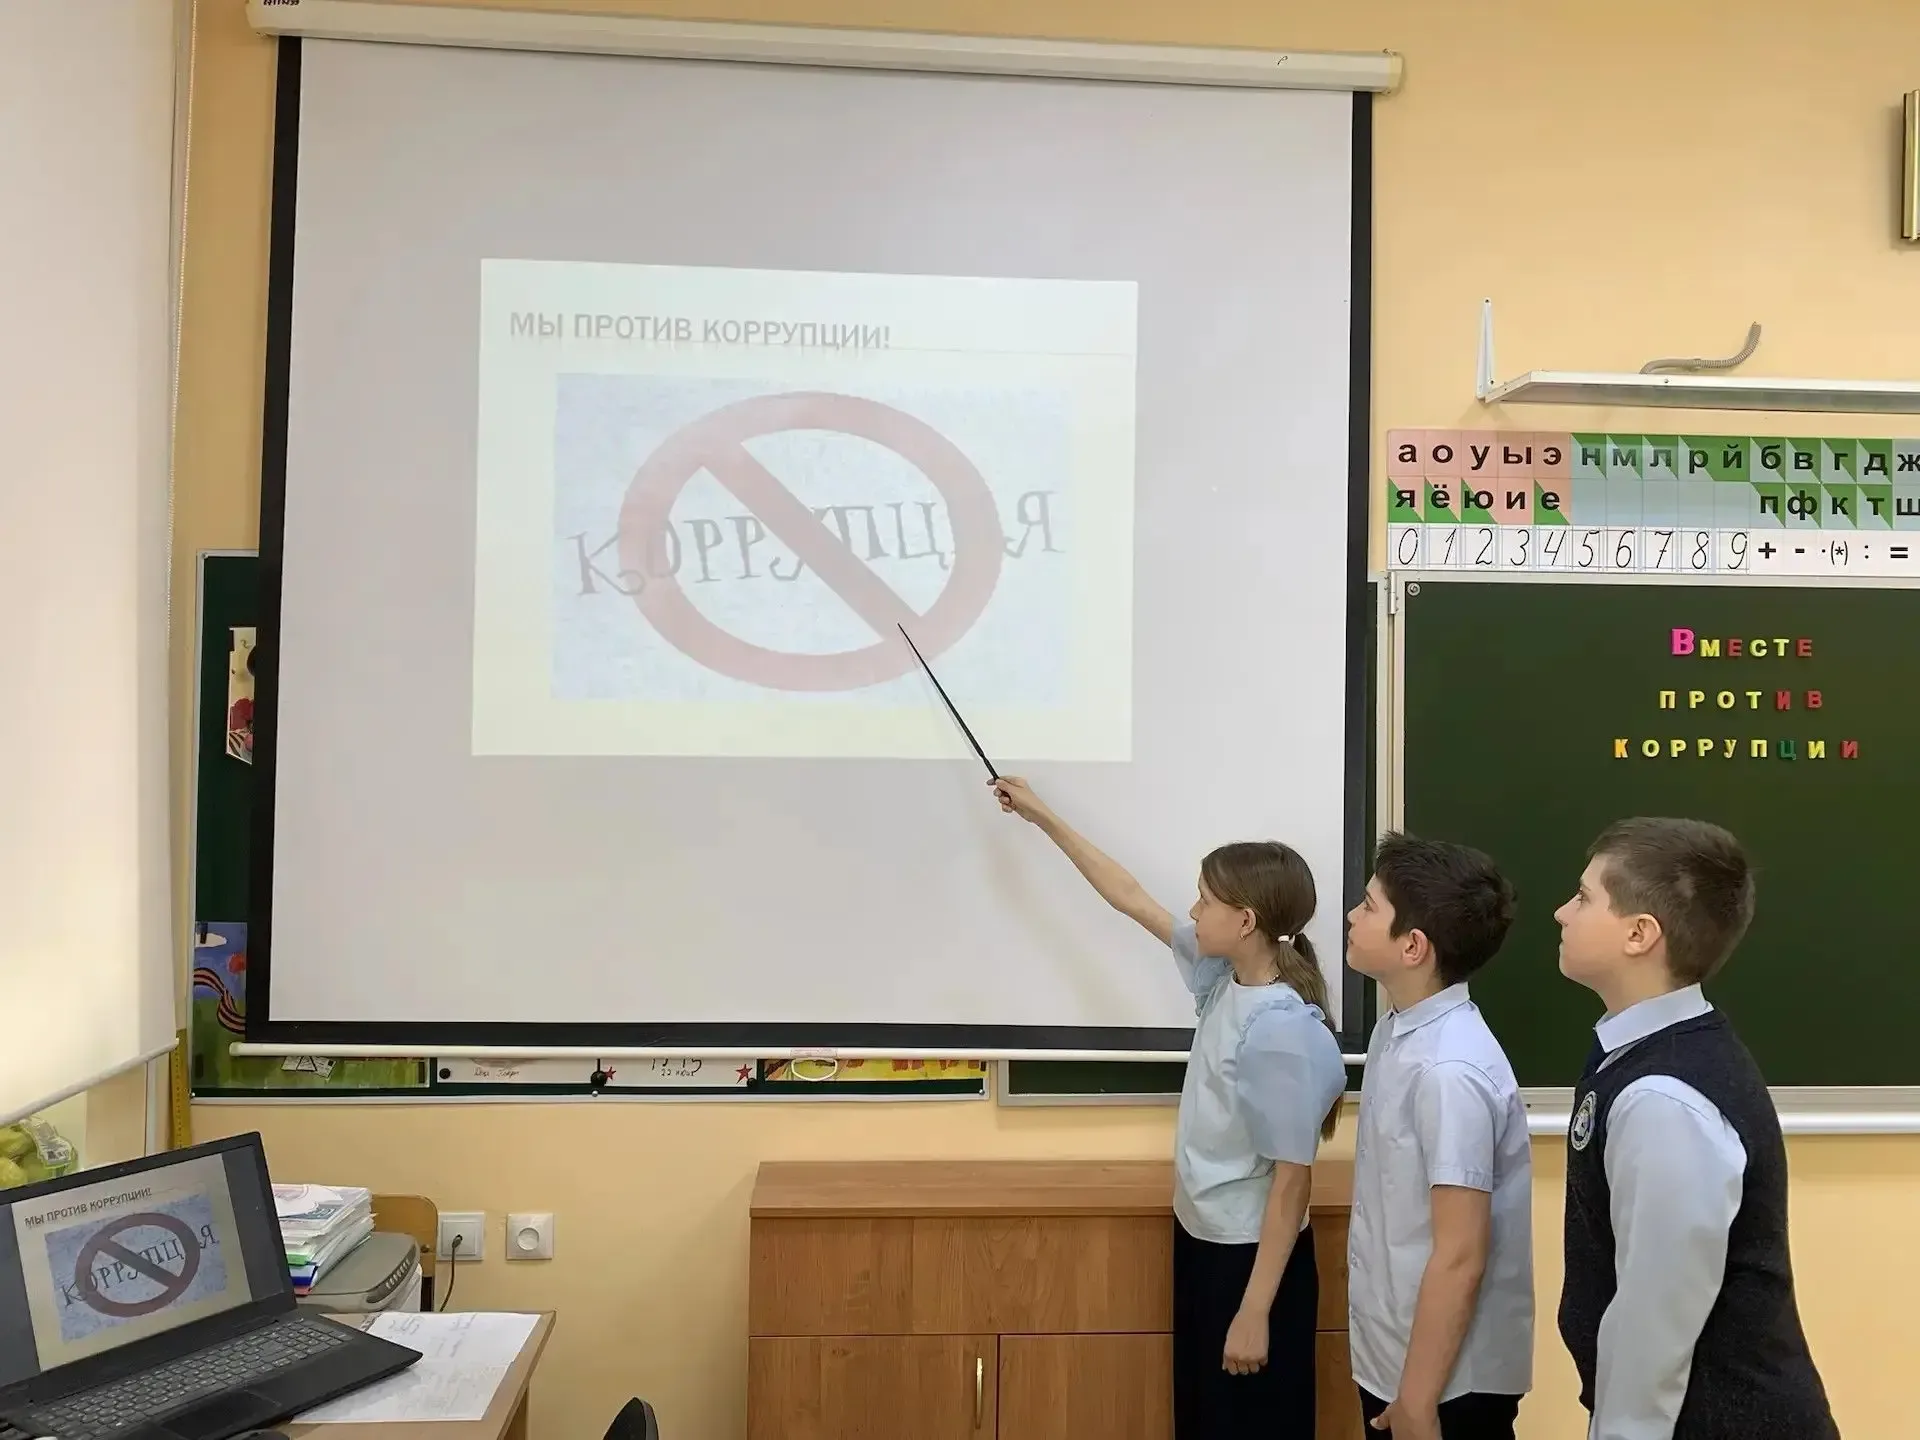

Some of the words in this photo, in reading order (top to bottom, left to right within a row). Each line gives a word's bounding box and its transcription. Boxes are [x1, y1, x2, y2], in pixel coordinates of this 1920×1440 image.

[510, 312, 563, 337] МЫ
[574, 314, 692, 341] ПРОТИВ
[703, 318, 890, 351] КОРРУПЦИИ!
[1659, 691, 1823, 709] ПРОТИВ
[1614, 739, 1858, 760] КОРРУПЦИИ
[24, 1213, 44, 1226] МЫ
[47, 1205, 88, 1221] ПРОТИВ
[90, 1188, 151, 1211] КОРРУПЦИИ!
